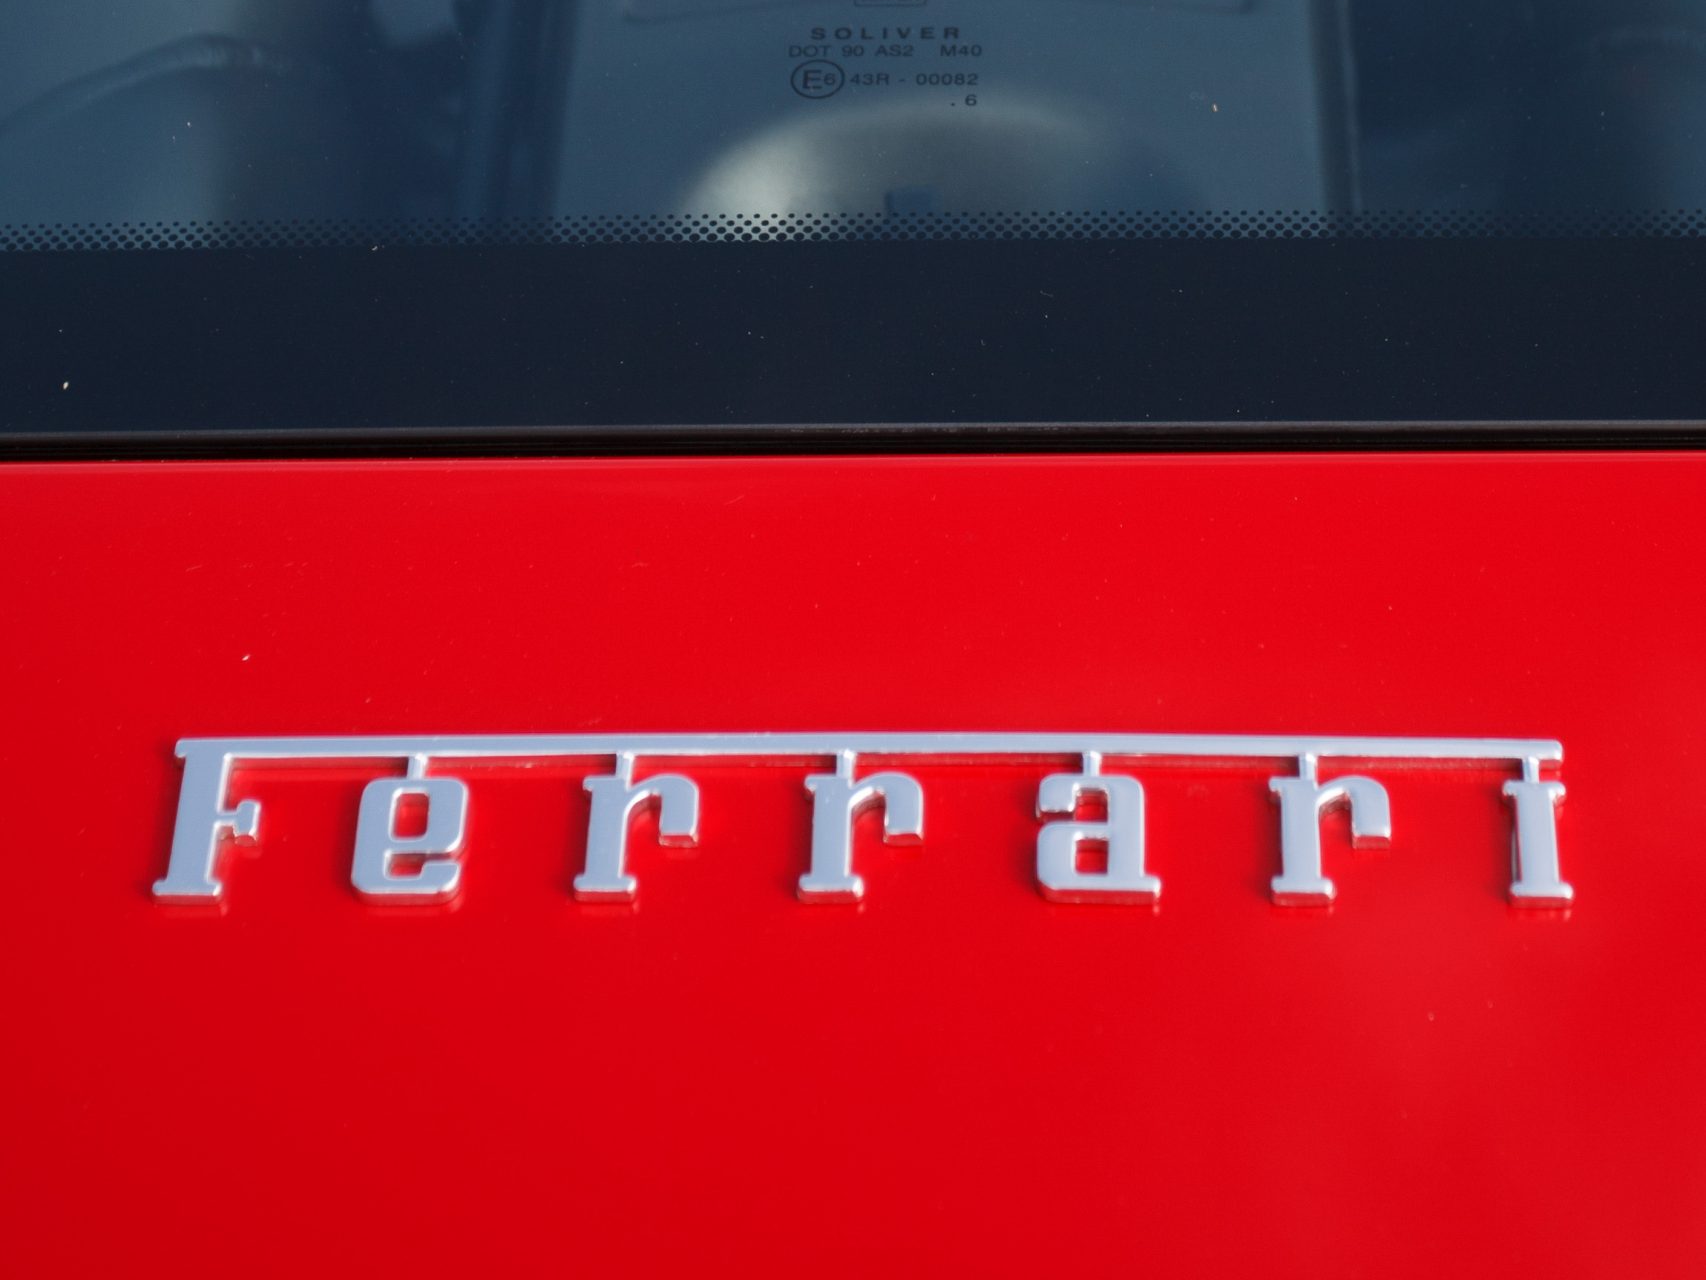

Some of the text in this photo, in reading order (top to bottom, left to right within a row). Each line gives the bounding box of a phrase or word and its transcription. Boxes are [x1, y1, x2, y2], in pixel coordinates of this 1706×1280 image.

[810, 26, 961, 40] SOLIVER
[789, 44, 982, 58] DOT 90 AS2 M40
[849, 73, 890, 86] 43R
[916, 73, 979, 86] 00082
[152, 733, 1575, 905] Ferrari
